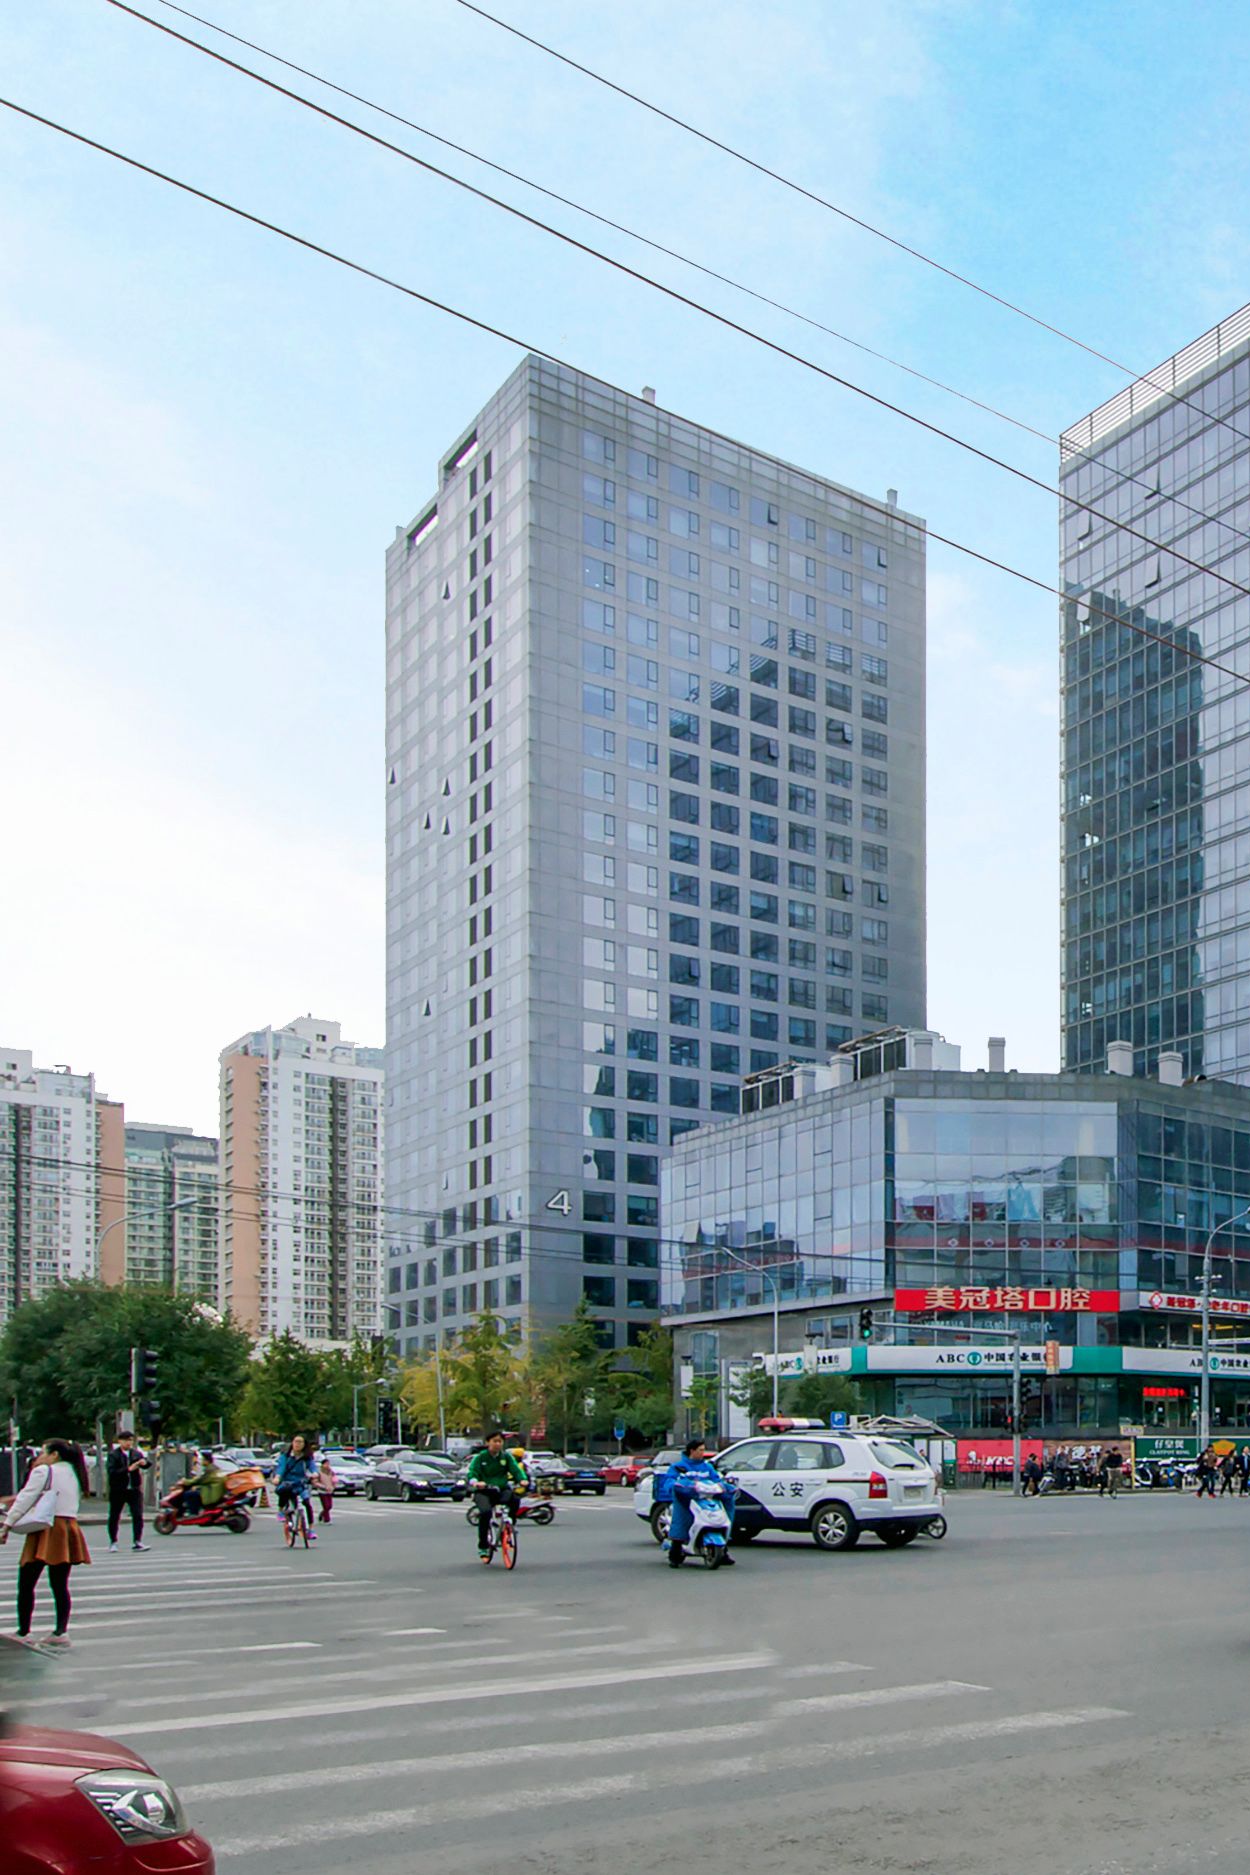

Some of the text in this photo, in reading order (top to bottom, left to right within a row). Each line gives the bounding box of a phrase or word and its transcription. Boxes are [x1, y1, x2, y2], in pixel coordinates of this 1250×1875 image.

[546, 1190, 572, 1216] 4
[925, 1287, 1091, 1311] 美冠塔口腔
[936, 1353, 966, 1364] ABC
[834, 1413, 843, 1422] P
[772, 1482, 804, 1498] 公安
